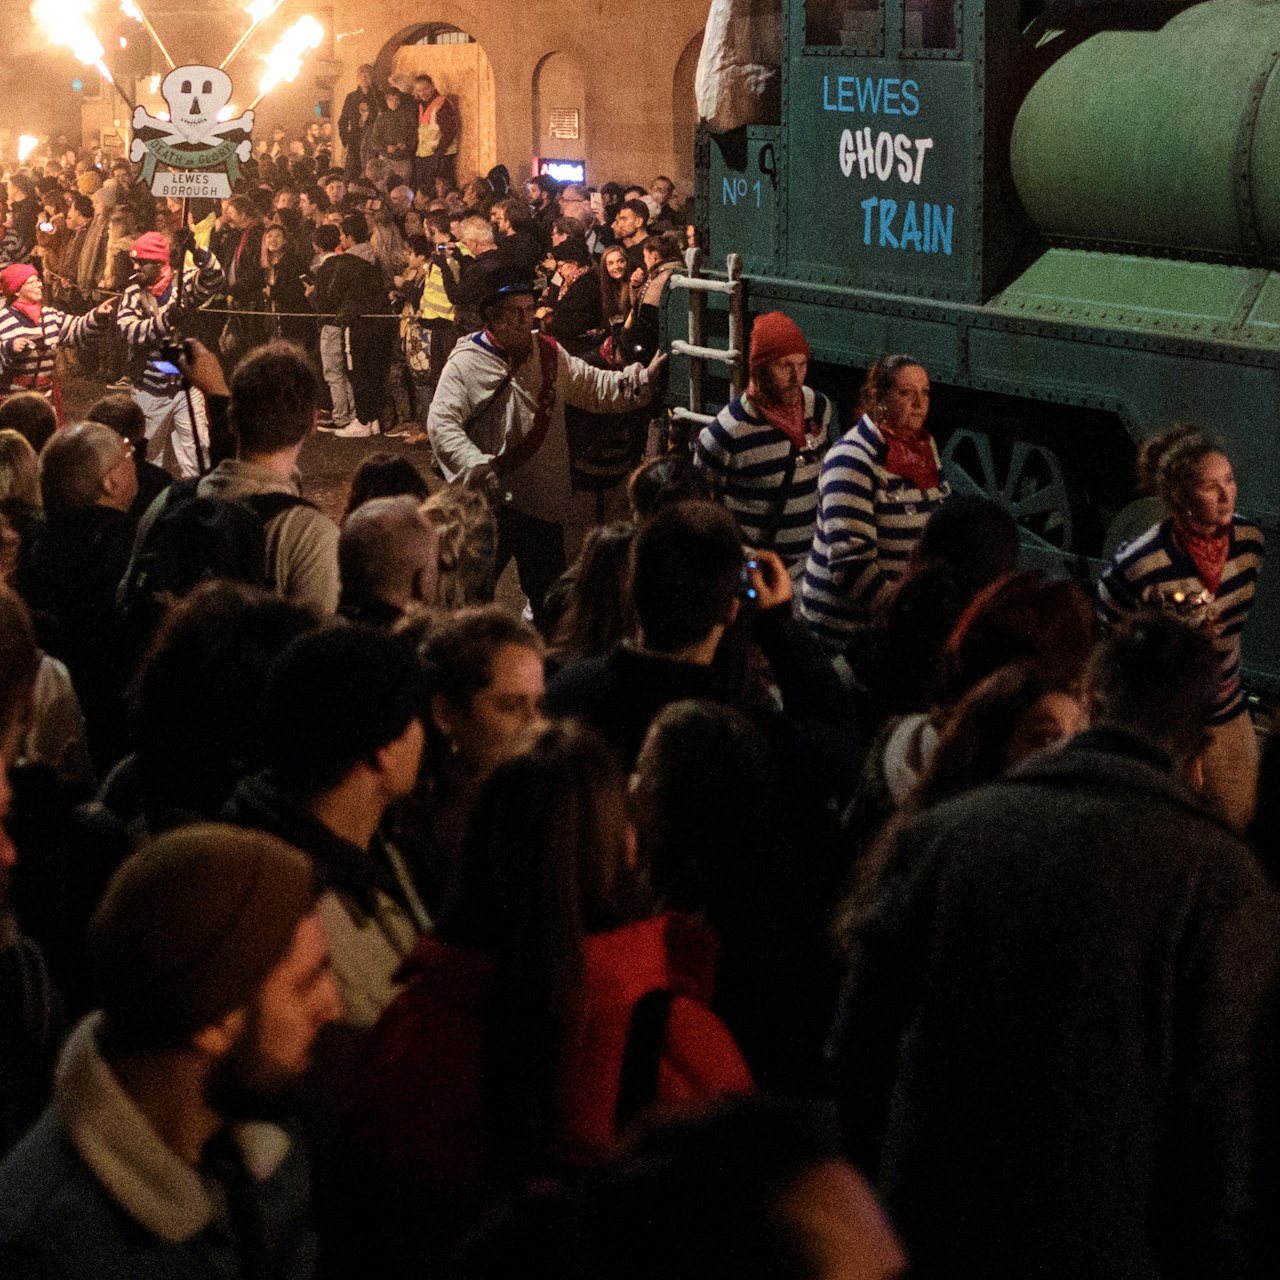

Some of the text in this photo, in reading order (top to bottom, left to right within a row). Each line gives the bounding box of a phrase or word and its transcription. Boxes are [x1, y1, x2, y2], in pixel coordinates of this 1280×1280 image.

[823, 76, 919, 116] LEWES
[150, 140, 182, 163] DEATH
[198, 143, 231, 163] GLORY
[839, 126, 933, 185] GHOST
[163, 186, 217, 196] BOROUGH
[172, 174, 209, 184] LEWES
[753, 180, 761, 209] 1
[861, 196, 955, 256] TRAIN
